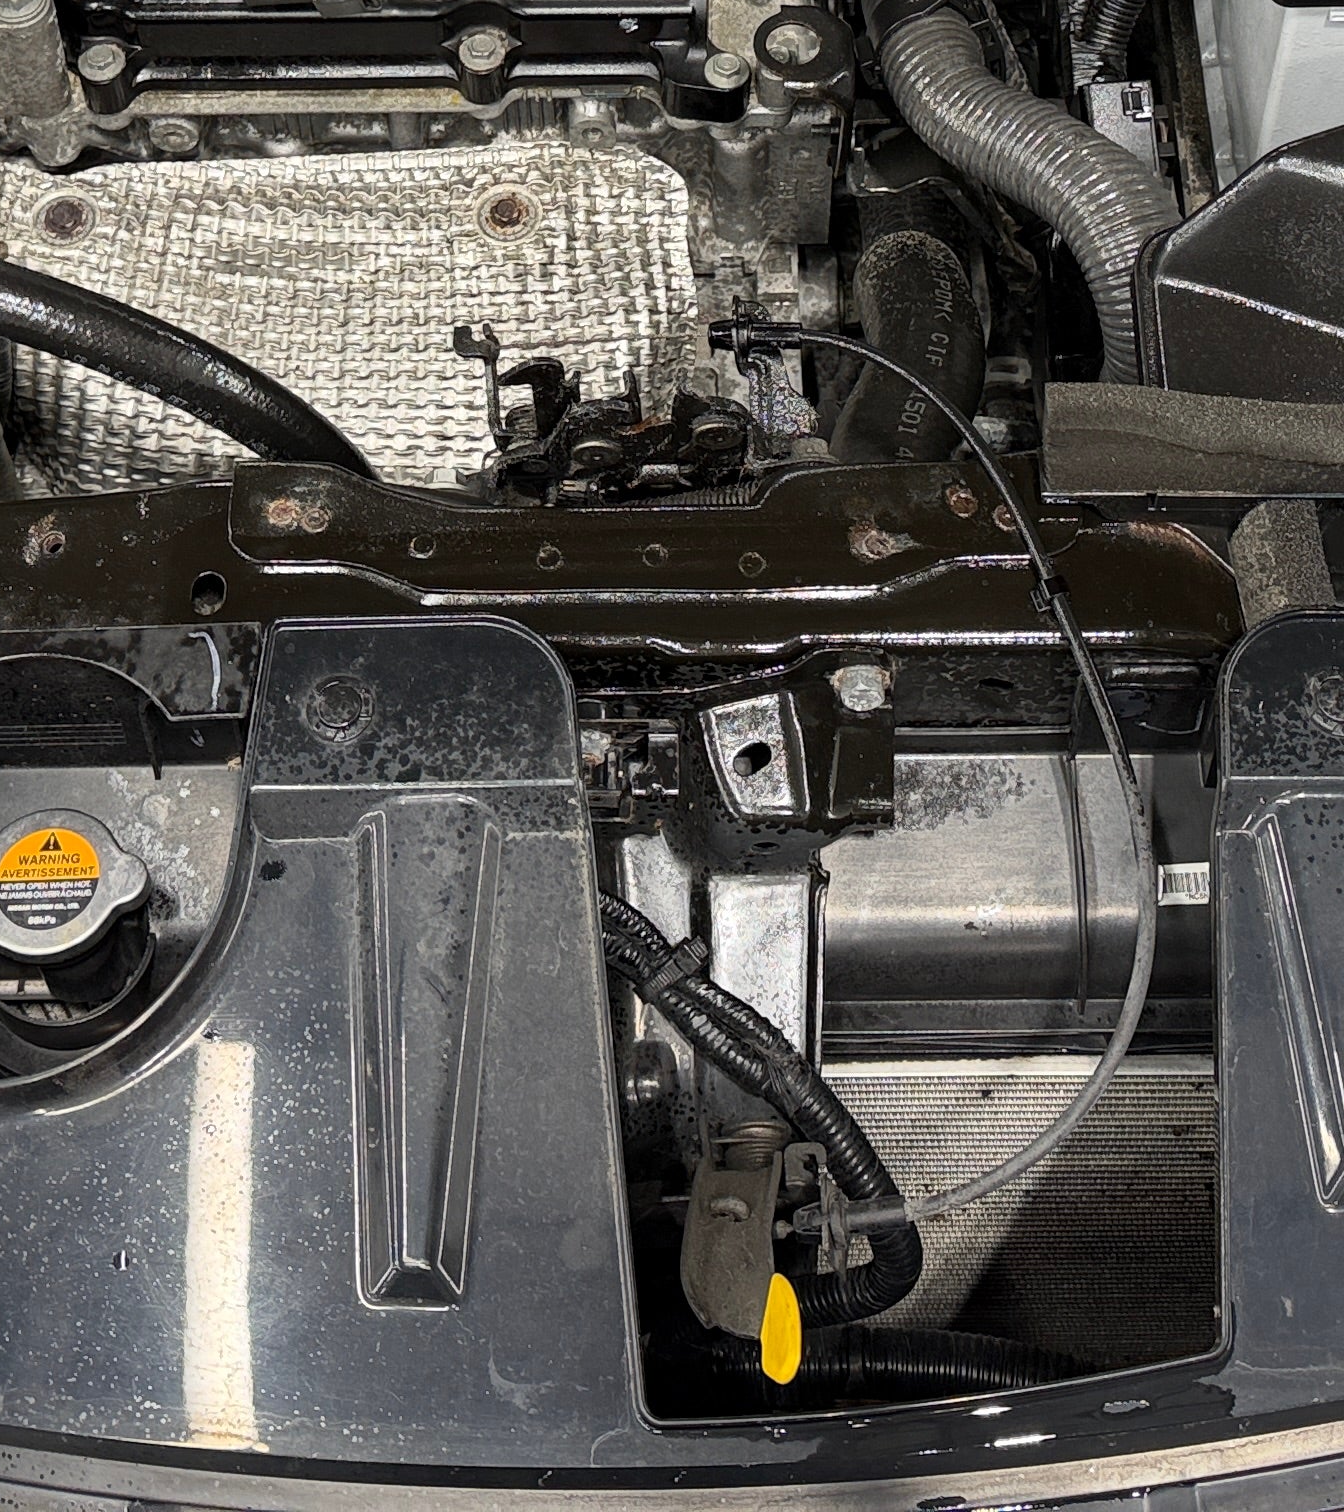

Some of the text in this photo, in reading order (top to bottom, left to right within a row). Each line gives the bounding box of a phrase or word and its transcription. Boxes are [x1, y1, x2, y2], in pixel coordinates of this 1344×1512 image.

[18, 853, 80, 865] WARNING
[1, 866, 95, 878] AVERTISSEMENT
[27, 882, 48, 890] OPEN
[50, 881, 73, 889] WHEN
[74, 880, 92, 888] HOT.
